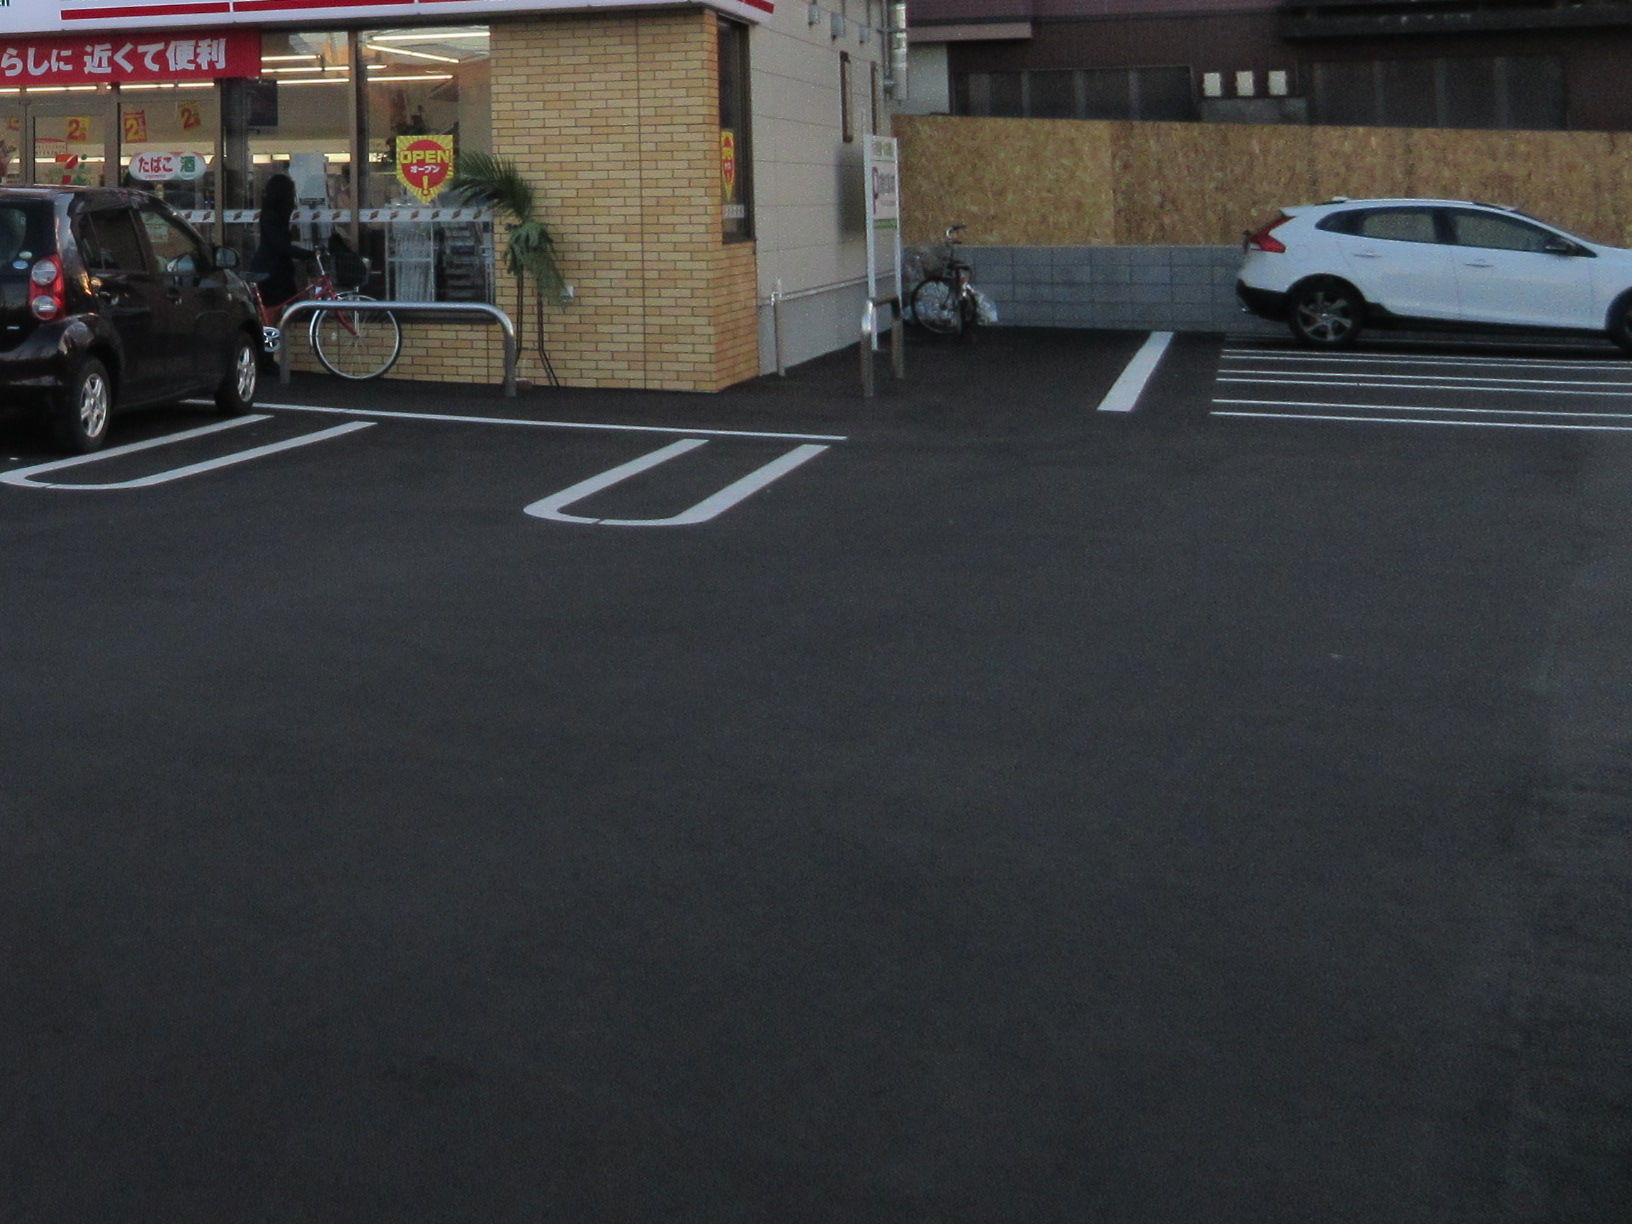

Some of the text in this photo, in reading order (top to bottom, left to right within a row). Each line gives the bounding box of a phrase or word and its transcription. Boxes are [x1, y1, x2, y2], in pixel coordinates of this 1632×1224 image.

[83, 38, 226, 74] 近くて便利
[138, 156, 196, 173] たばこ 酒
[399, 150, 450, 164] OPEN
